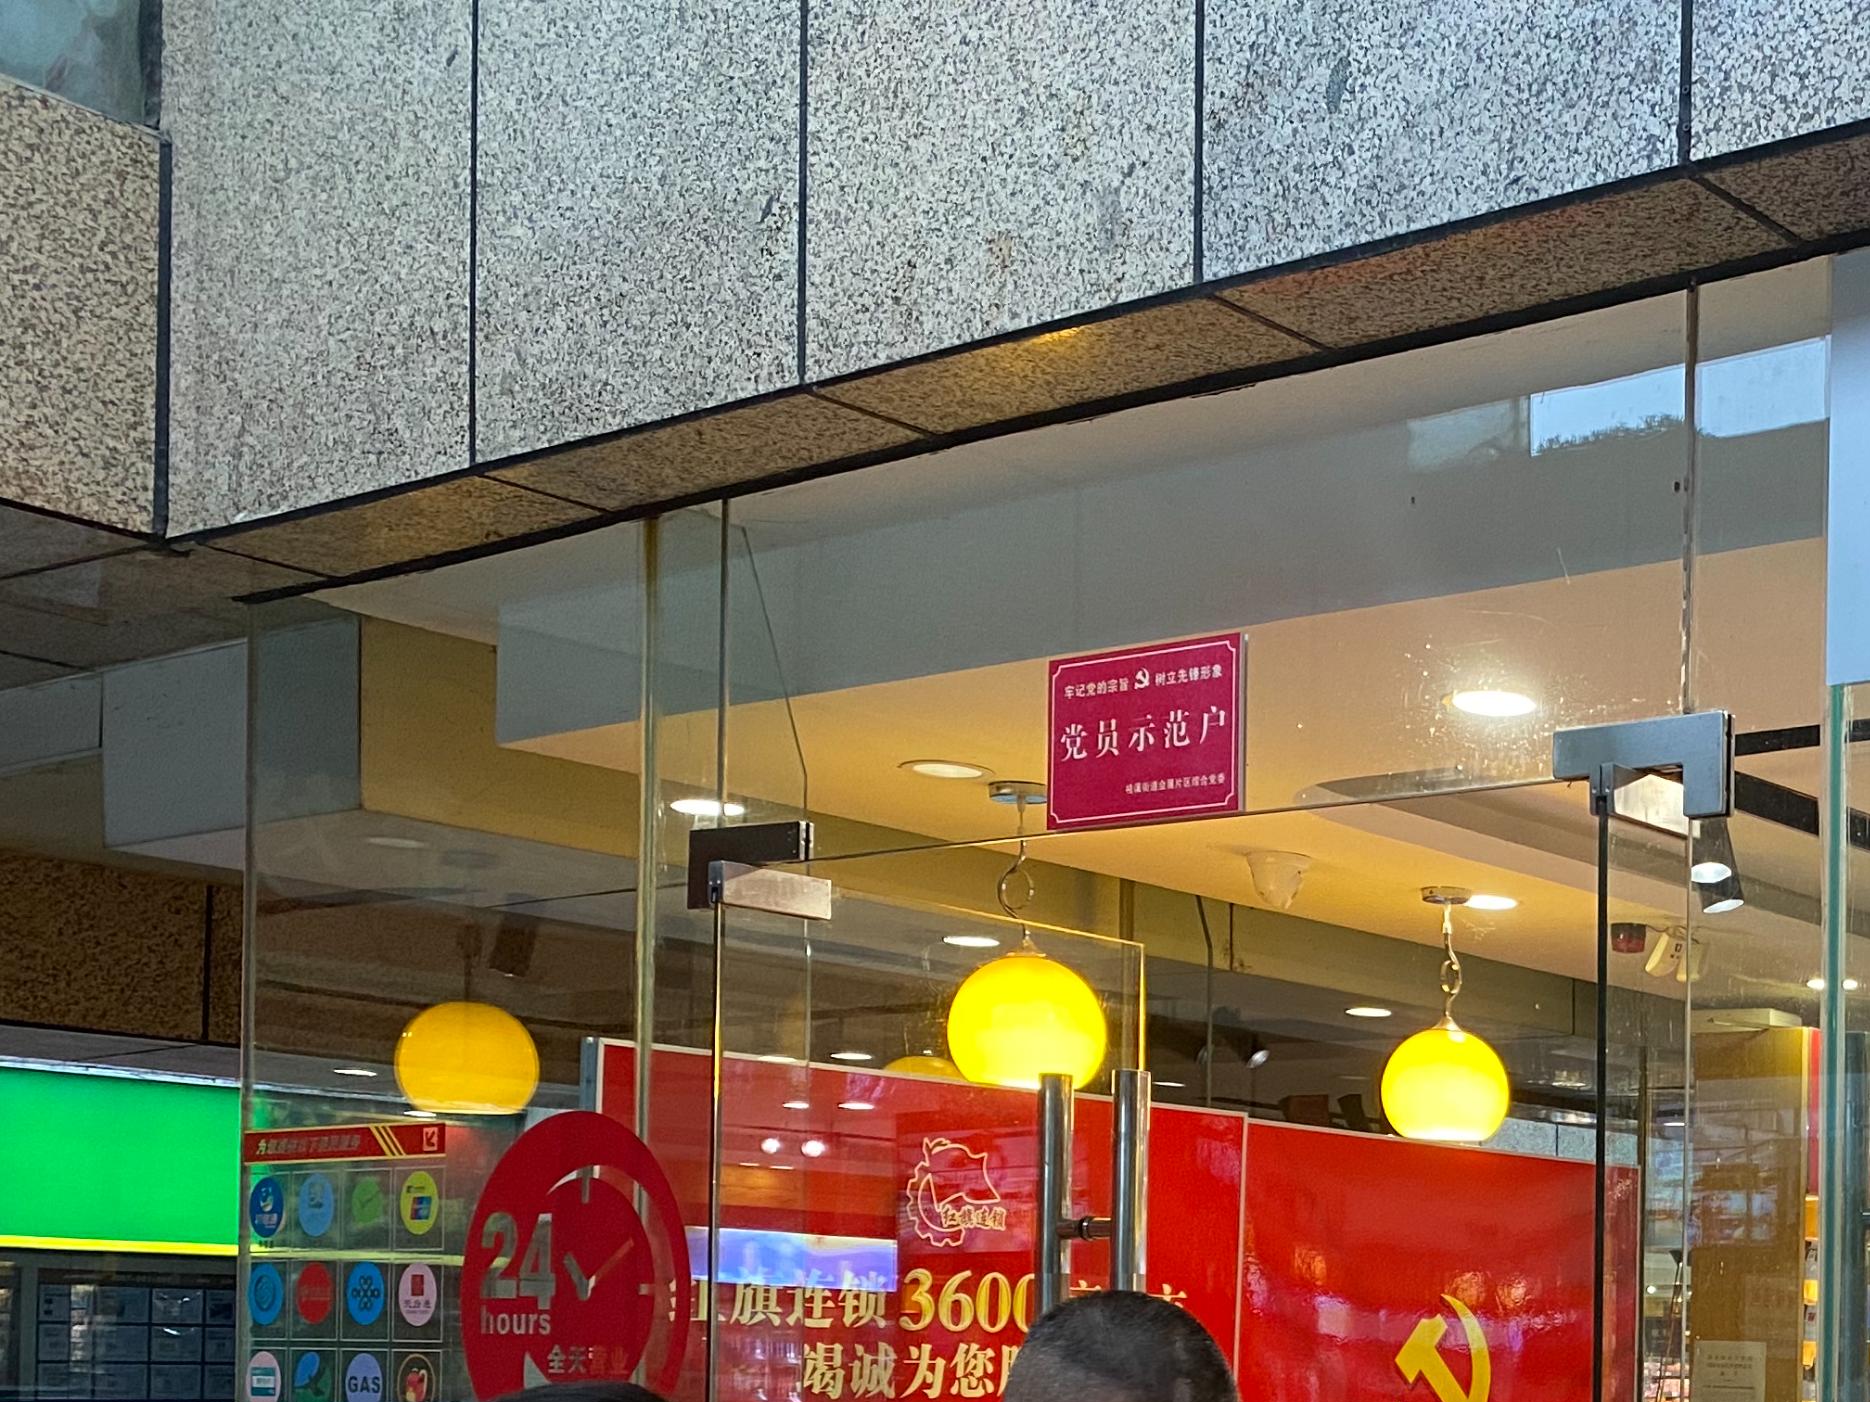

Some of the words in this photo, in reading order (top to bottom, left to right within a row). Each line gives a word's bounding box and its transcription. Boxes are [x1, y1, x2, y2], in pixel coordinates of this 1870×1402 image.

[1063, 678, 1129, 699] 牢记党的宗旨
[1060, 705, 1226, 762] 党员示范户
[480, 1211, 556, 1311] 24
[480, 1305, 551, 1335] hours
[547, 1344, 630, 1375] 全天营业
[349, 1375, 381, 1394] GAS
